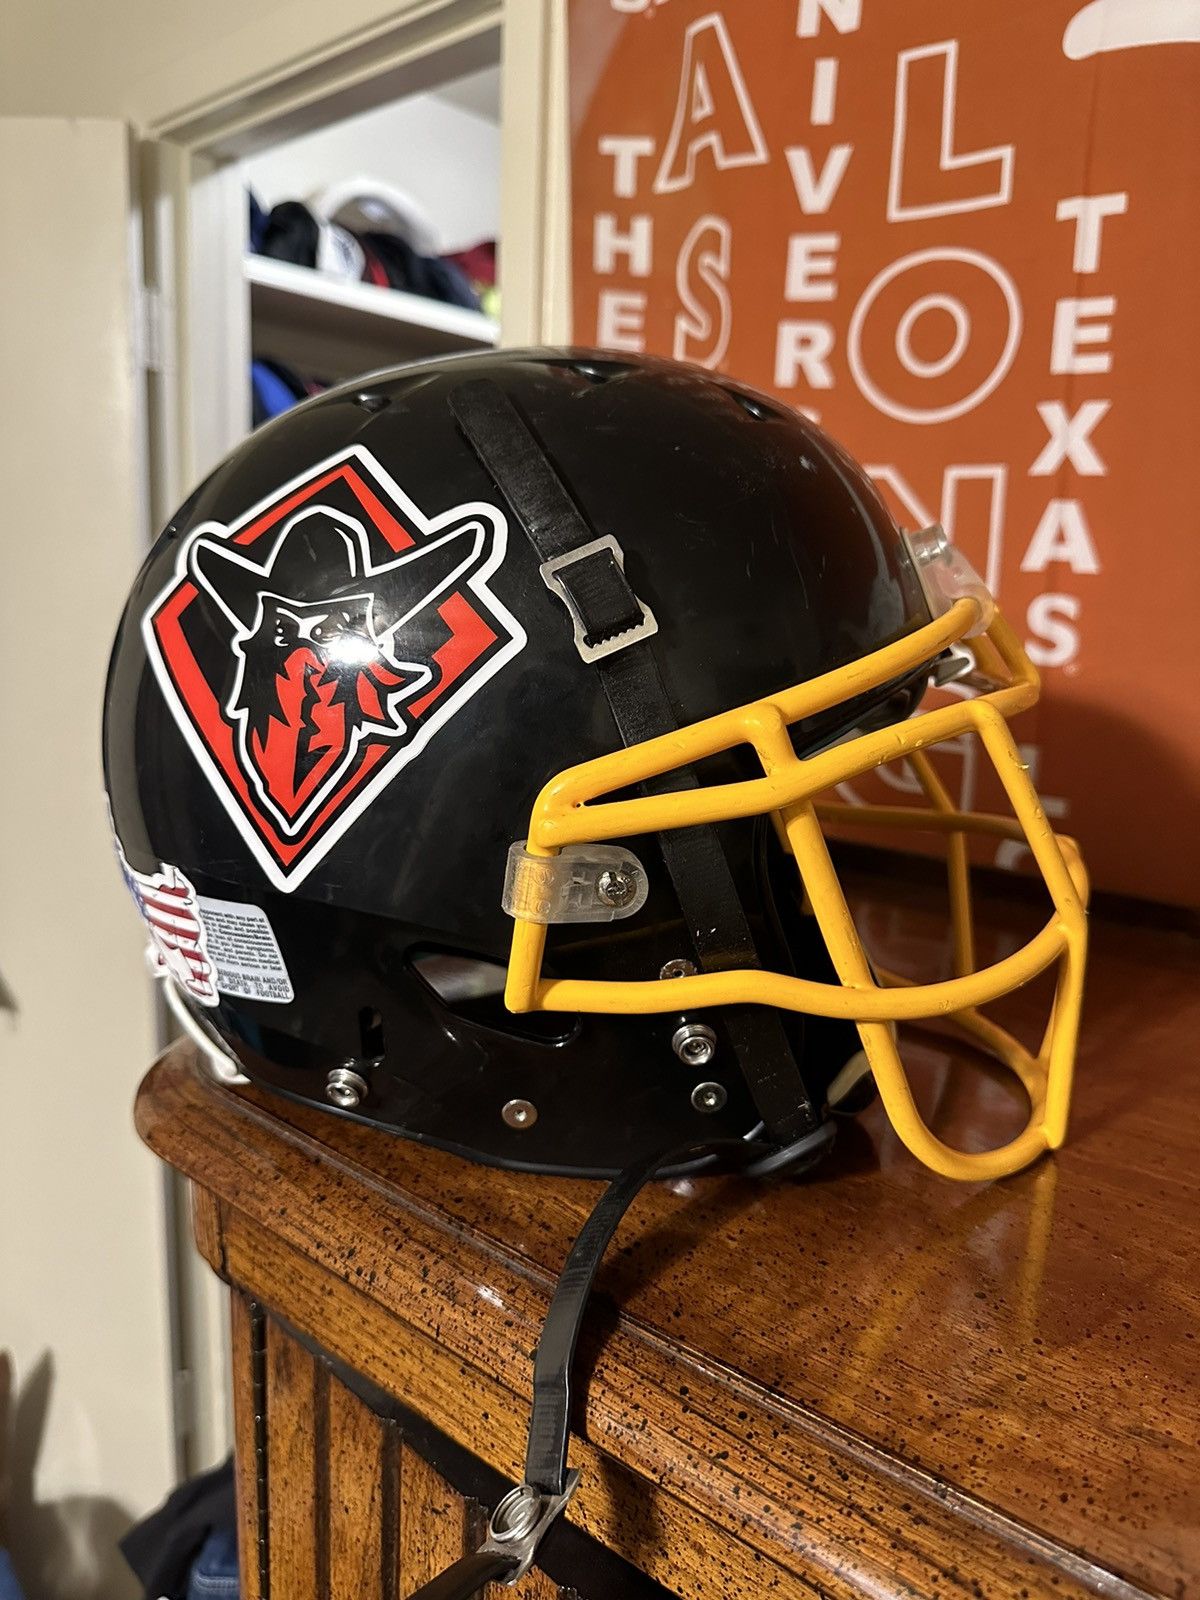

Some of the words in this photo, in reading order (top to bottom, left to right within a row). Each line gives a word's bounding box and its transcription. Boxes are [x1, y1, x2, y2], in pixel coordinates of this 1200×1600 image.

[592, 133, 656, 354] THE
[1024, 192, 1128, 668] TEXAS
[256, 989, 291, 999] FOOTBALL
[269, 984, 290, 992] AVOID
